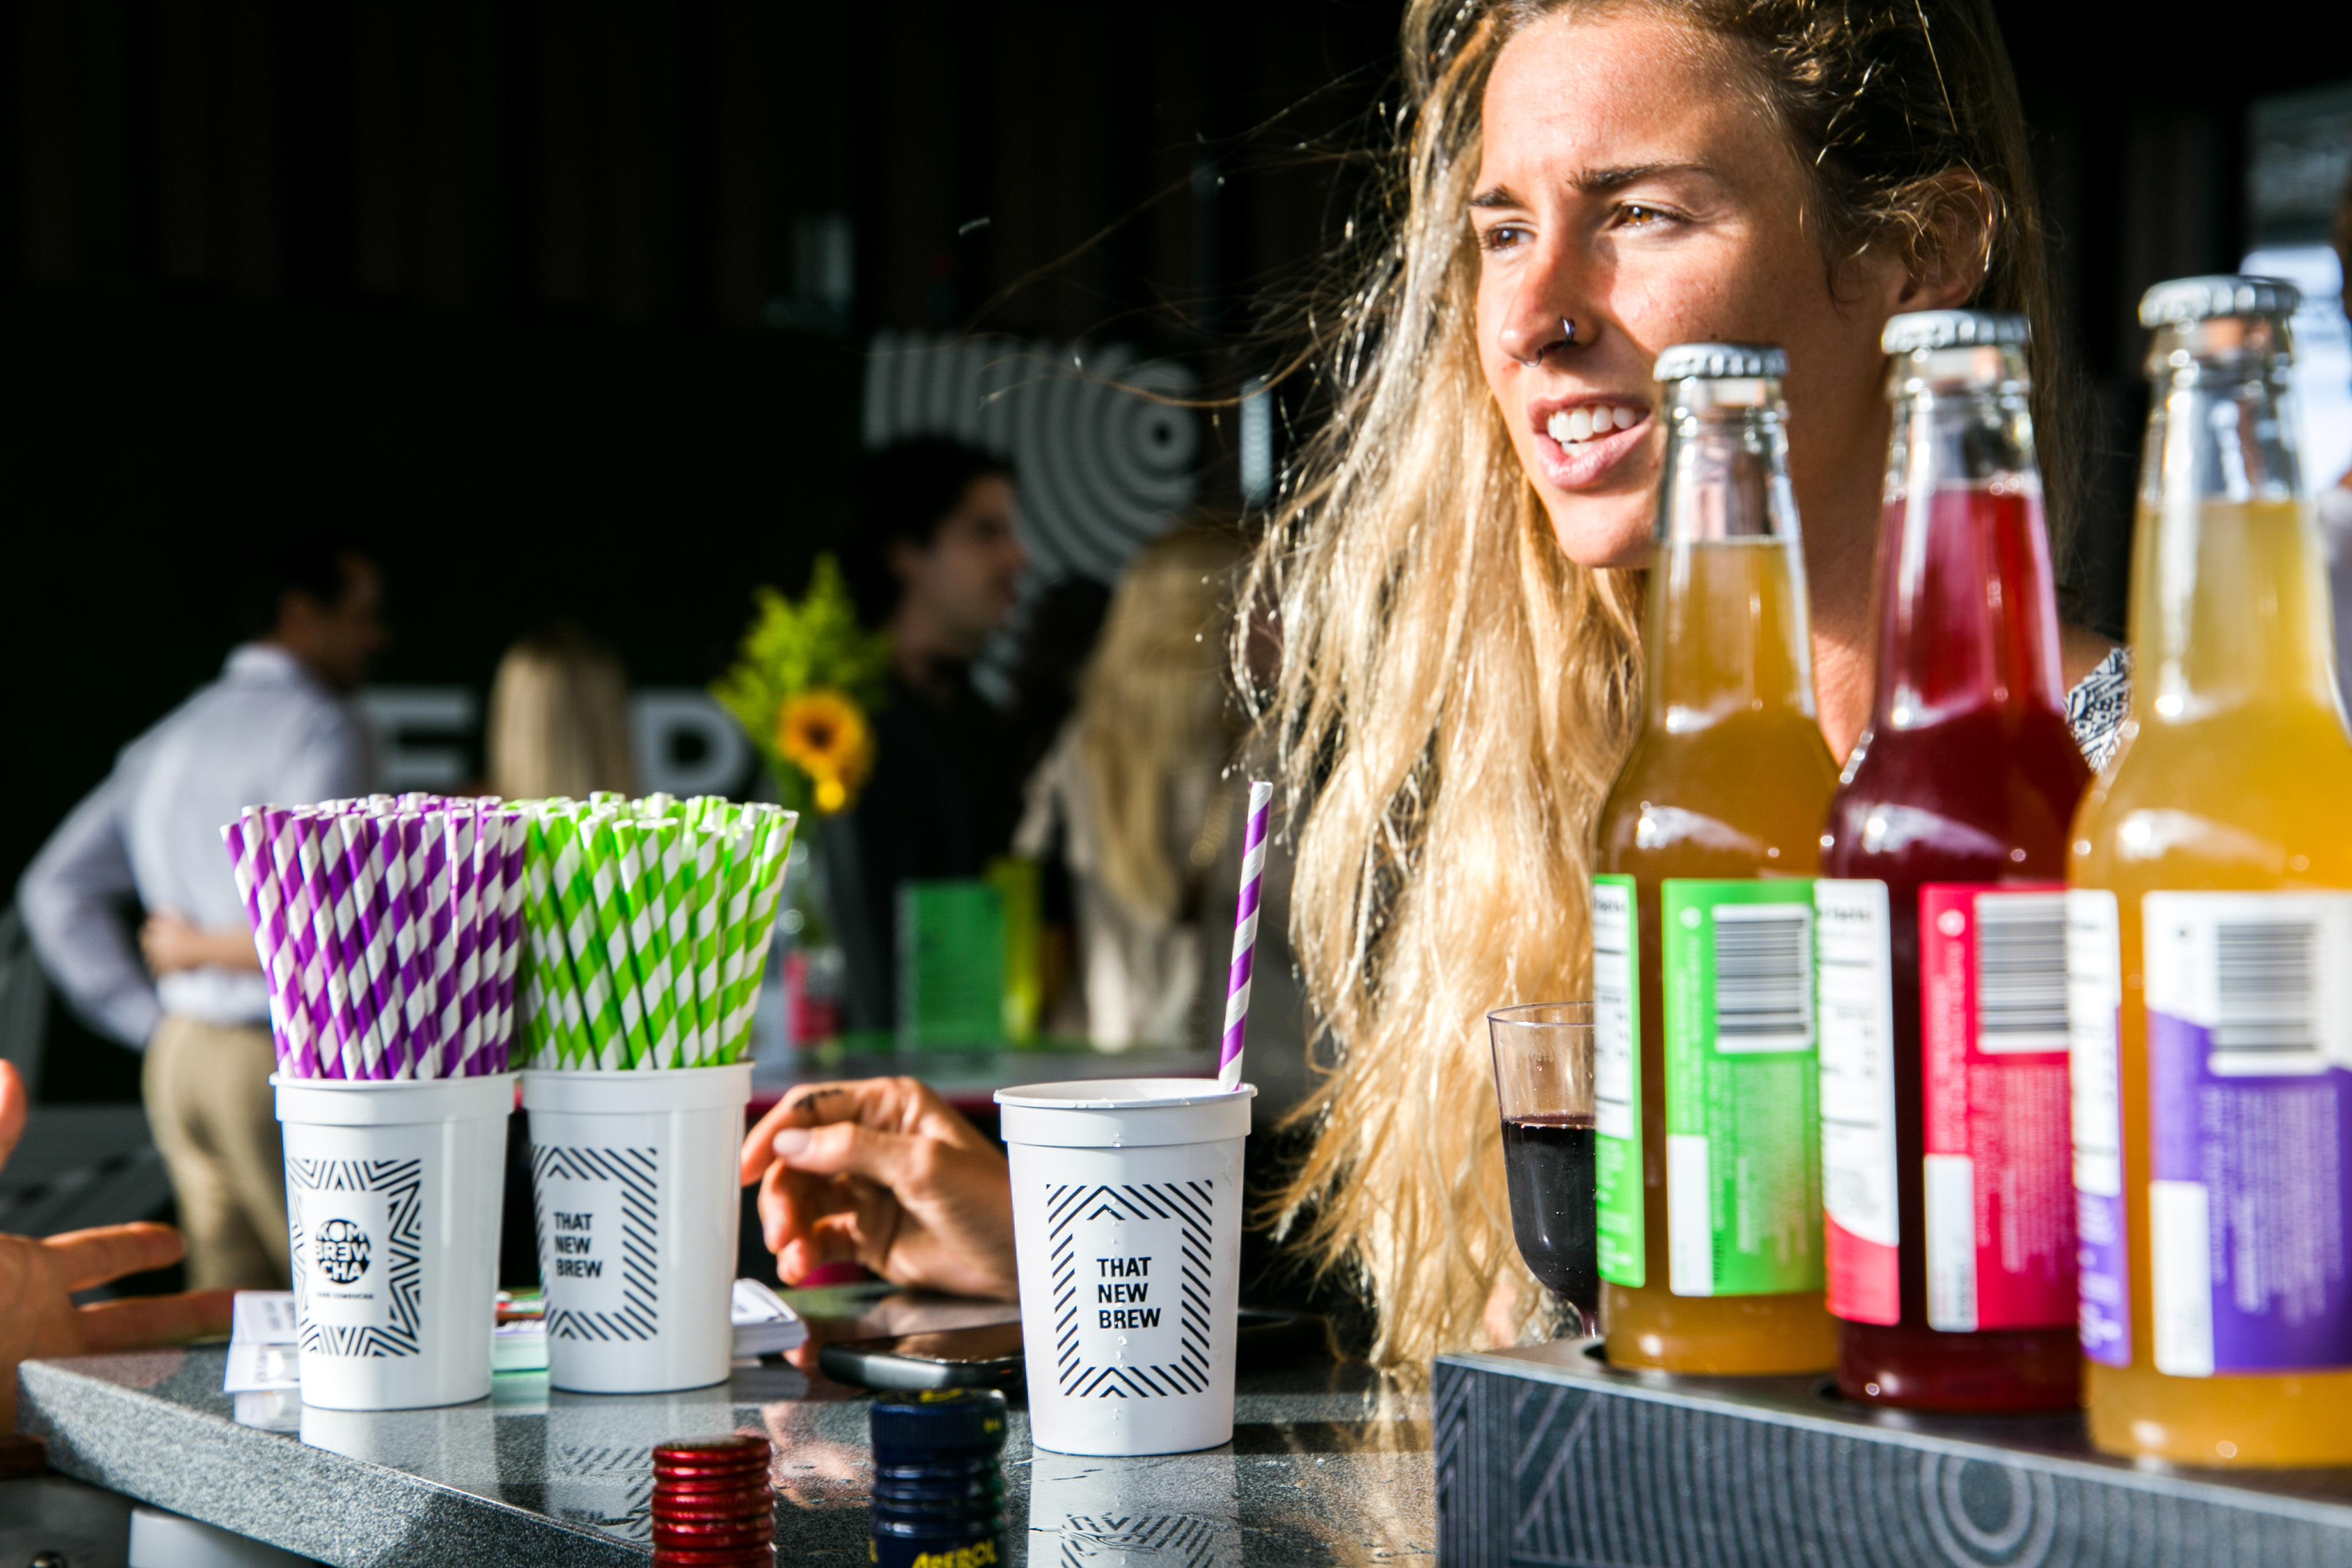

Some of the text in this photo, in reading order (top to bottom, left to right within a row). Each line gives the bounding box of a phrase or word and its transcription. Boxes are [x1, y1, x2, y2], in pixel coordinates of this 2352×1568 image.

[316, 1221, 366, 1241] KOM
[554, 1212, 593, 1230] THAT
[555, 1235, 591, 1254] NEW
[319, 1260, 363, 1281] CHA
[556, 1258, 603, 1278] BREW
[1096, 1257, 1151, 1277] THAT
[1098, 1283, 1148, 1303] NEW
[1099, 1308, 1161, 1329] BREW
